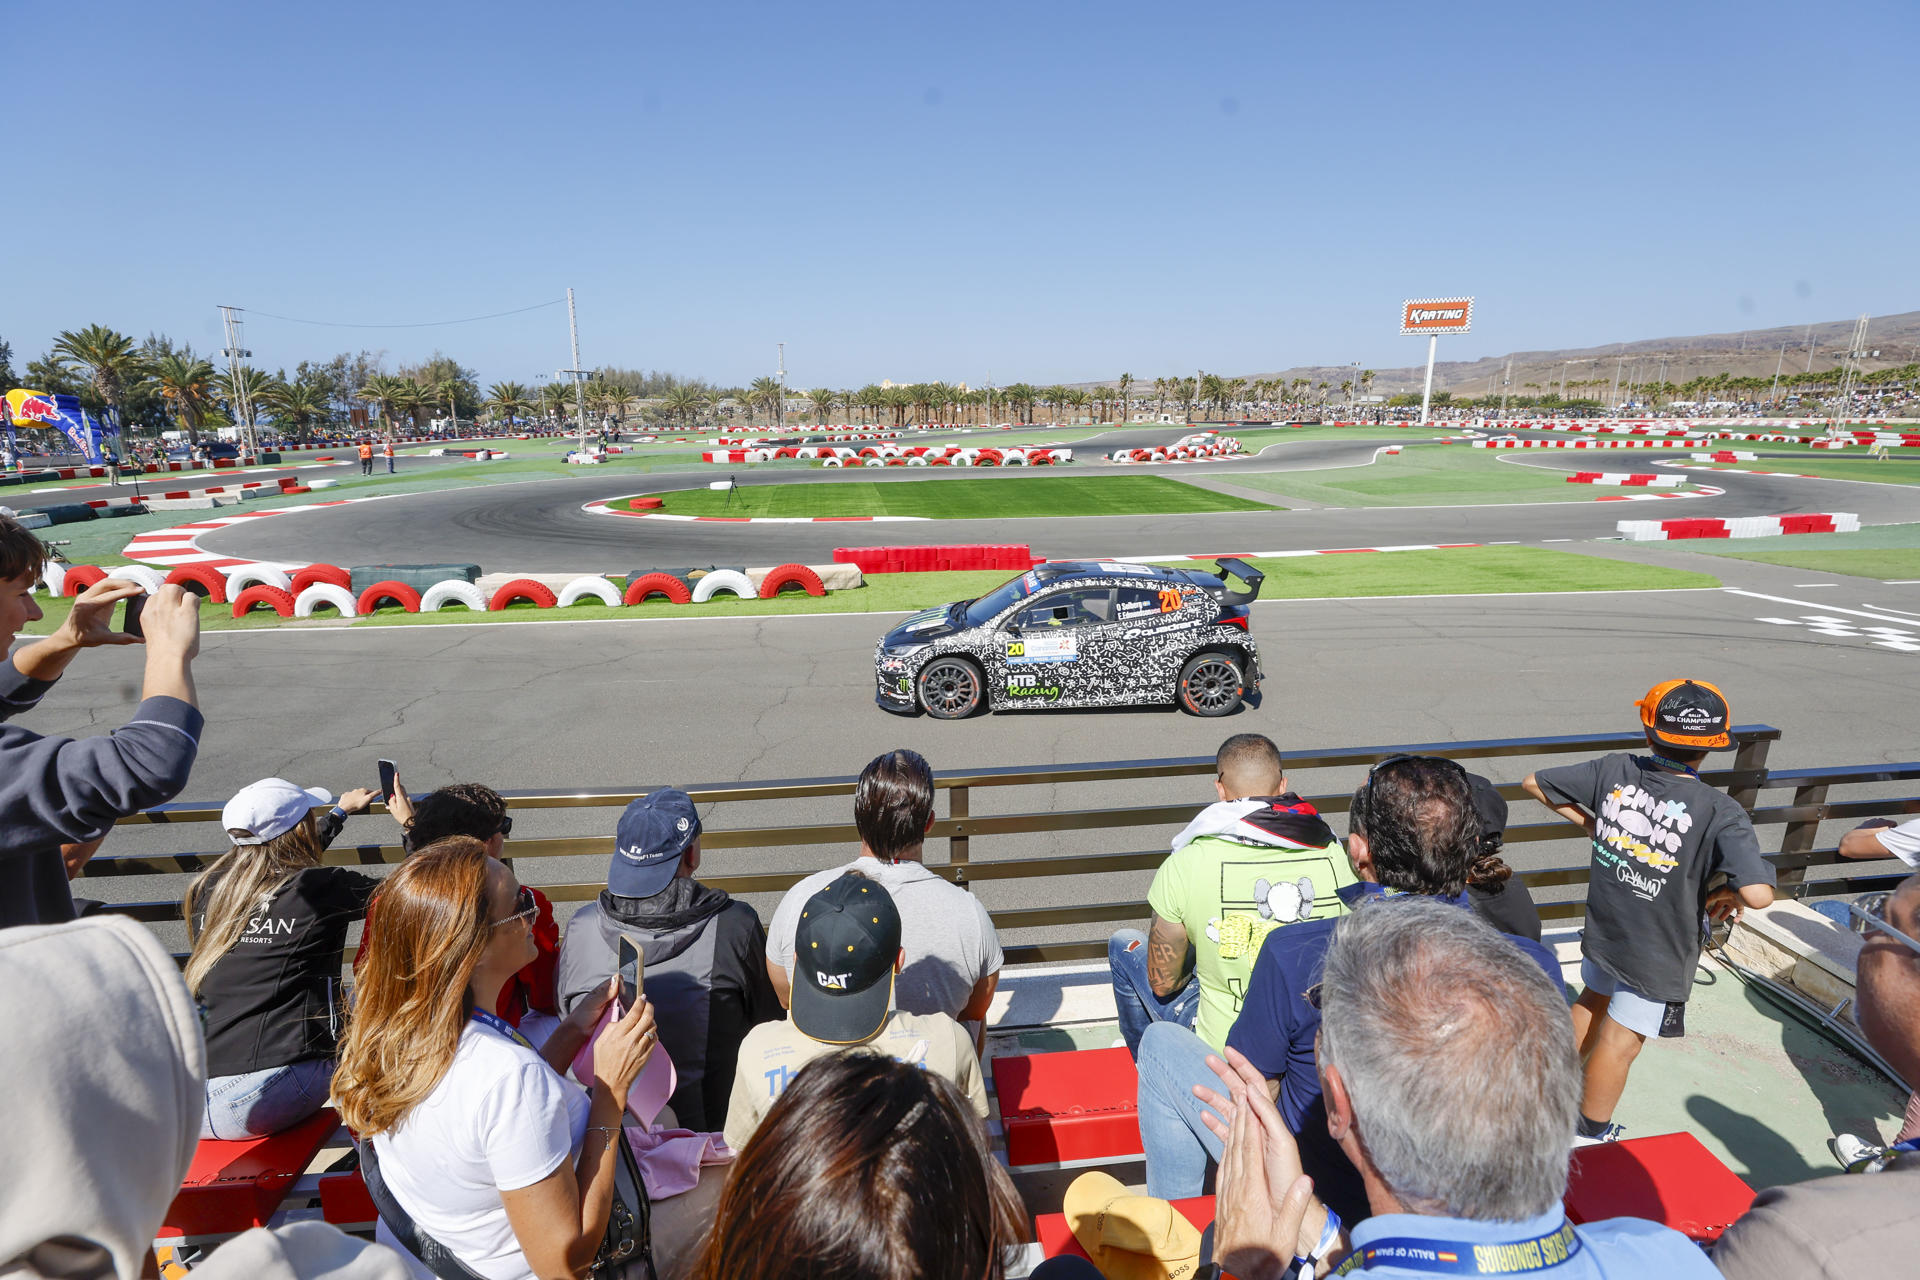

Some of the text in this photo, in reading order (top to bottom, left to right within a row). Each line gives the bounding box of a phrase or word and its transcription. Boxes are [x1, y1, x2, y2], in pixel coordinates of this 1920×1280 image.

[1409, 309, 1465, 324] KARTING
[1158, 589, 1182, 613] 20
[1007, 643, 1025, 656] 20
[1006, 685, 1059, 702] Racing
[1677, 716, 1712, 724] CHAMPION
[240, 936, 272, 944] RESORTS
[816, 970, 848, 989] CAT
[1375, 1247, 1436, 1261] RALLY OF SPAIN
[1472, 1239, 1543, 1274] CANARIAS
[1168, 1263, 1190, 1280] BOSS
